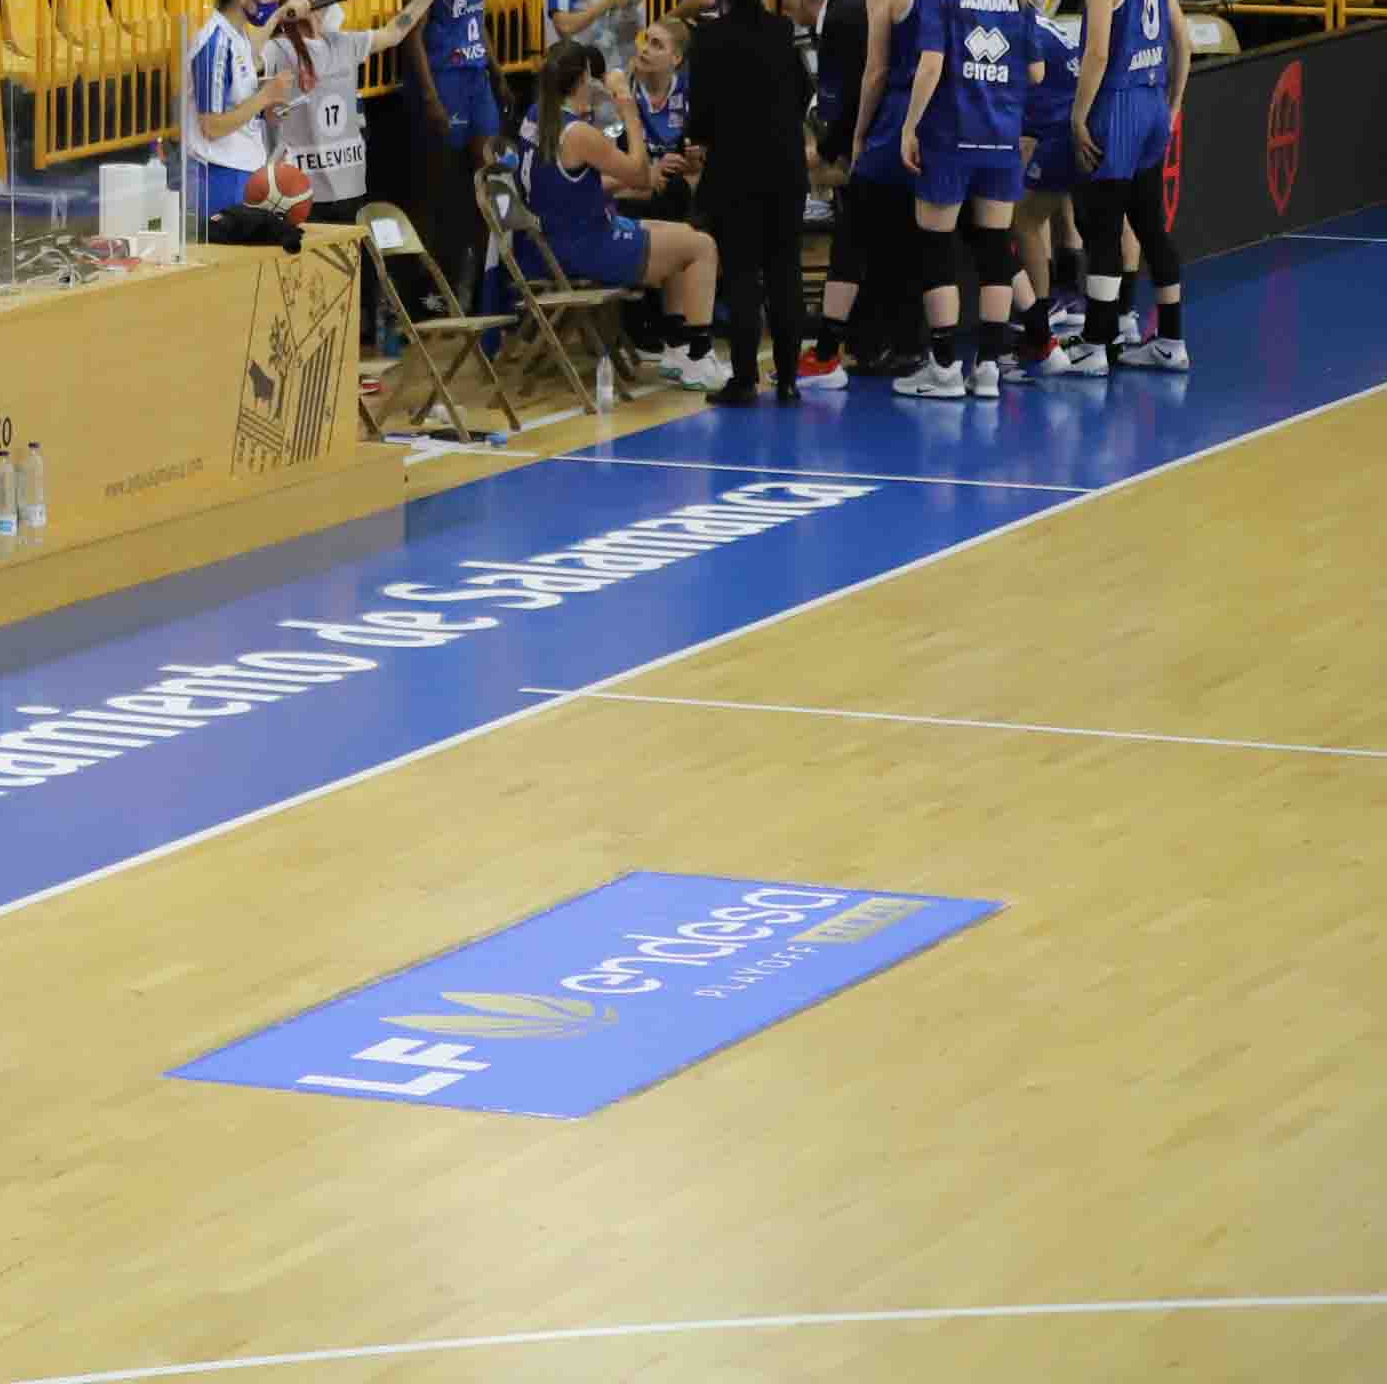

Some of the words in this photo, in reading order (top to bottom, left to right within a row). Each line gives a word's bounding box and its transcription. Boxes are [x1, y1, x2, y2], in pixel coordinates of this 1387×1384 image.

[324, 104, 340, 128] 17
[383, 481, 880, 611] Salamanca
[277, 611, 500, 649] de
[559, 887, 849, 995] endesa
[693, 943, 820, 1000] PLAYOFF
